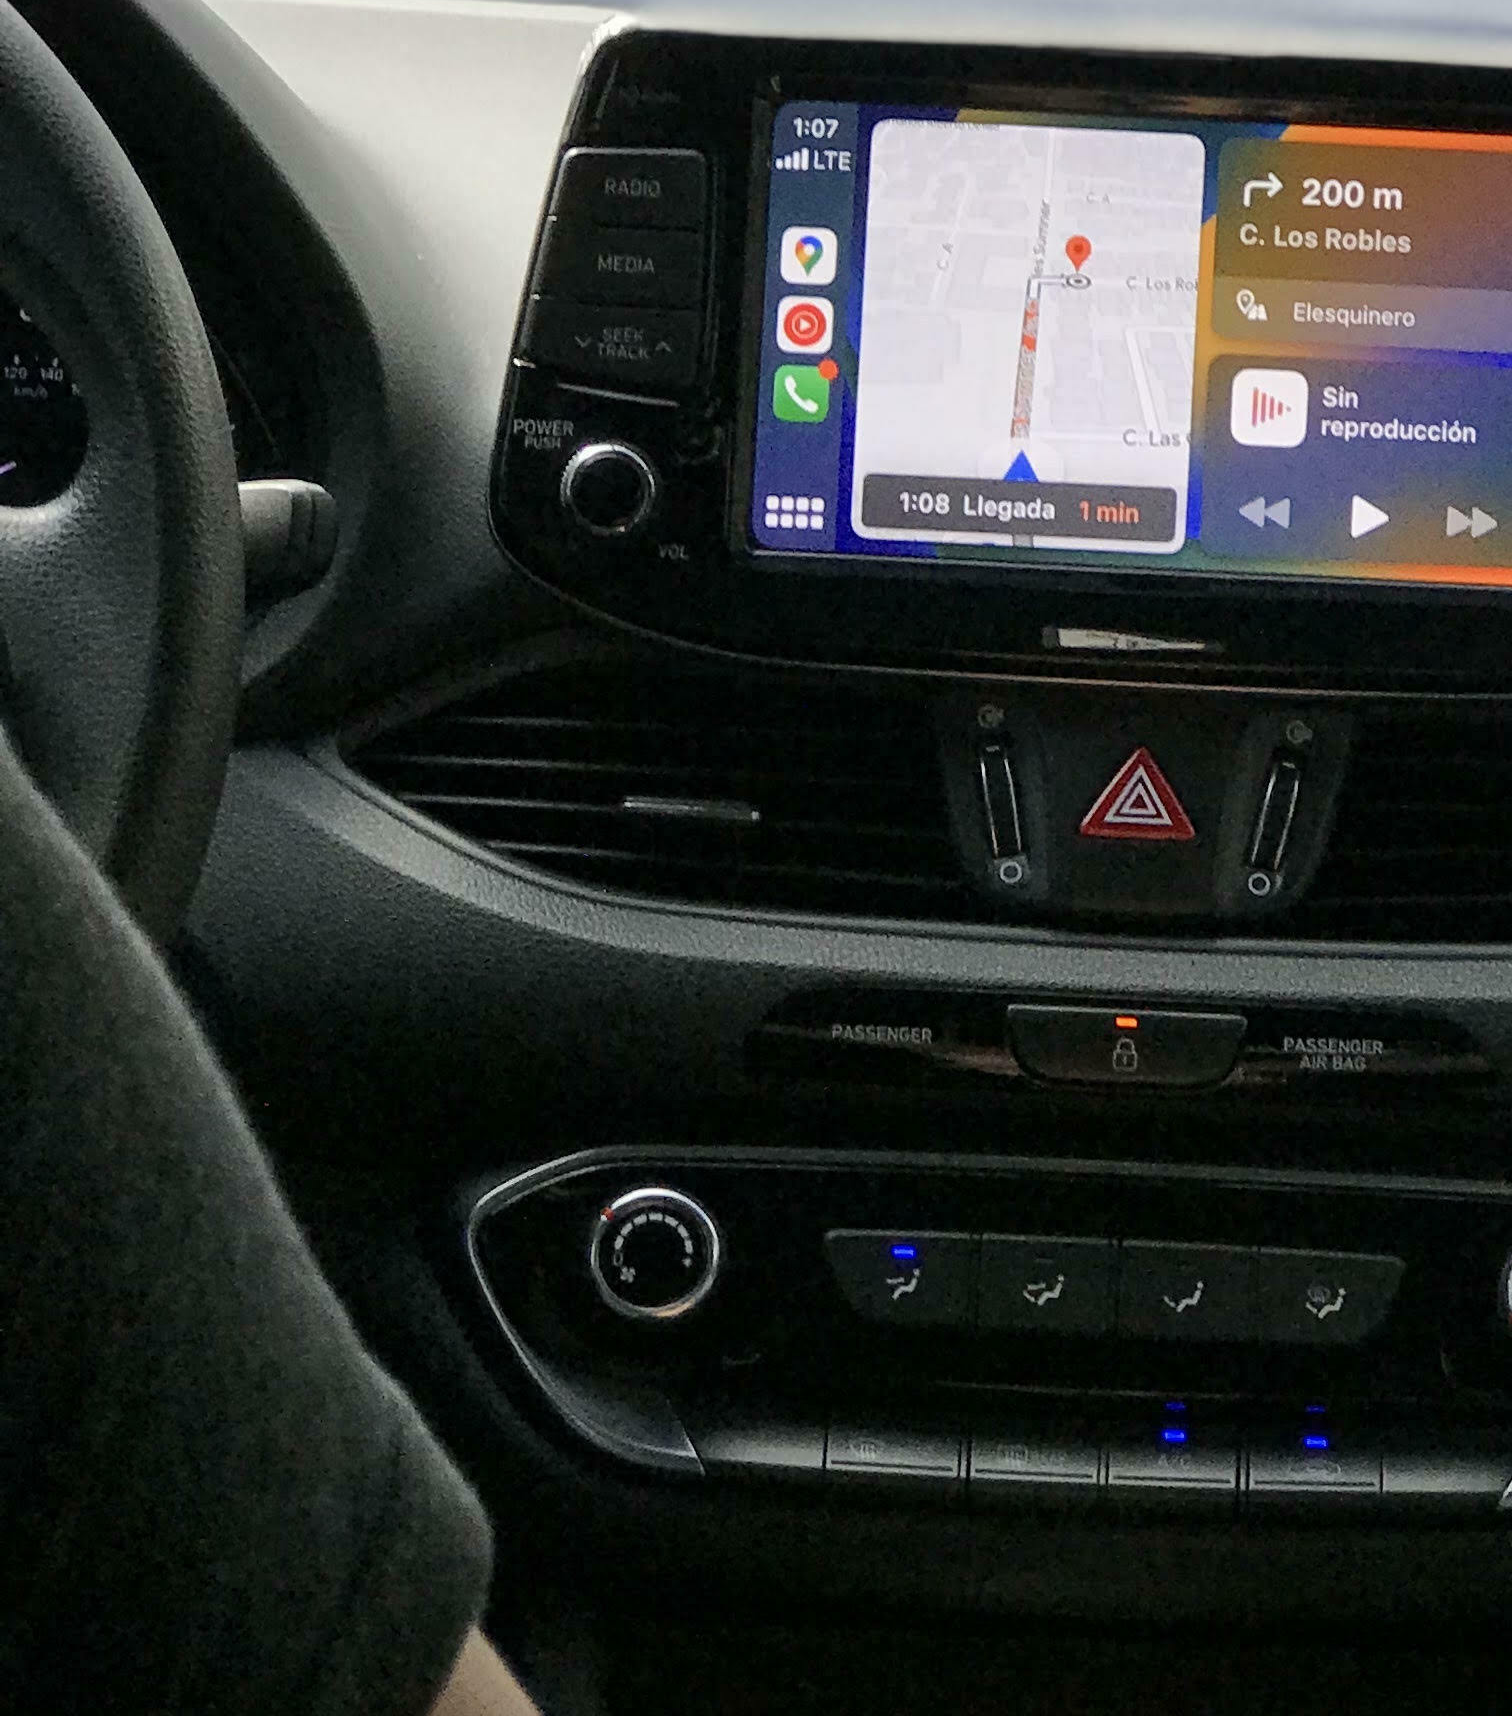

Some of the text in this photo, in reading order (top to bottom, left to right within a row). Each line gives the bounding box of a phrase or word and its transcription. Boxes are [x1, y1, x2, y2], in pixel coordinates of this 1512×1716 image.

[793, 117, 839, 139] 1:07
[813, 149, 851, 171] LTE
[604, 178, 661, 198] RADIO
[1301, 178, 1403, 210] 200 m
[1239, 223, 1412, 253] C. Los Robles
[597, 254, 655, 273] MEDIA
[1293, 301, 1416, 329] Elesquinero
[603, 327, 644, 343] SEEK
[597, 342, 650, 359] TRACK
[4, 366, 64, 382] 120 140
[1322, 386, 1358, 410] Sin
[513, 417, 575, 438] POWER
[1321, 417, 1477, 445] reproducción
[524, 434, 562, 450] PUSH
[1149, 430, 1181, 447] Las
[899, 491, 1140, 525] 1:08 Llegada 1 min
[657, 543, 689, 561] VOL
[831, 1023, 933, 1045] PASSENGER
[1282, 1036, 1384, 1057] PASSENGER
[1299, 1055, 1367, 1072] AIR BAG
